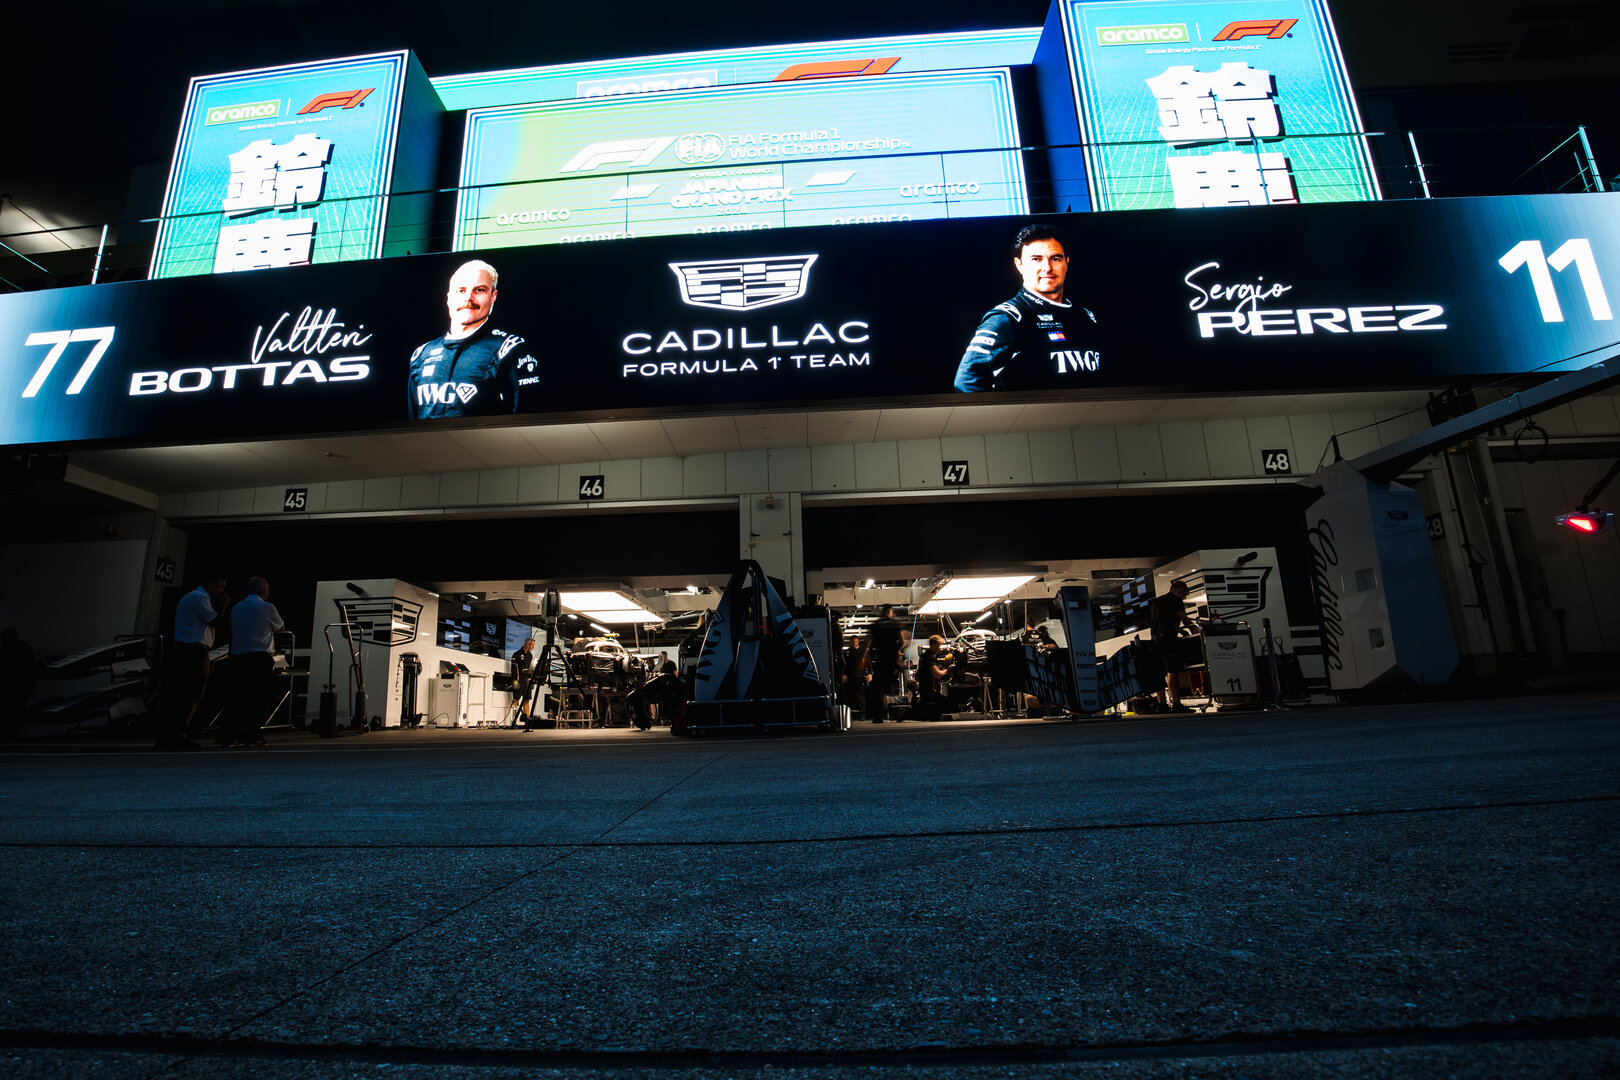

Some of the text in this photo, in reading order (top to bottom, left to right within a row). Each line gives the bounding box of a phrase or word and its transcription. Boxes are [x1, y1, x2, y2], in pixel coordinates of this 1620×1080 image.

[1101, 27, 1184, 43] aramco
[211, 103, 276, 122] aramco
[728, 127, 841, 147] FIA Formula 1
[728, 145, 779, 158] World
[900, 181, 980, 198] aramco
[496, 208, 570, 225] aramco
[1498, 238, 1614, 323] 11
[1184, 262, 1293, 335] Sergio
[1197, 304, 1448, 338] PEREZ
[251, 305, 373, 364] Valtteri
[622, 321, 870, 355] CADILLAC
[21, 326, 116, 398] 77
[623, 358, 758, 378] FORMULA
[790, 352, 870, 369] TEAM
[129, 355, 371, 396] BOTTAS
[1265, 453, 1289, 471] 48
[944, 464, 967, 482] 47
[580, 479, 603, 496] 46
[284, 492, 306, 509] 45
[156, 561, 174, 580] 45
[1307, 518, 1344, 671] Cadillac
[1226, 678, 1242, 692] 11
